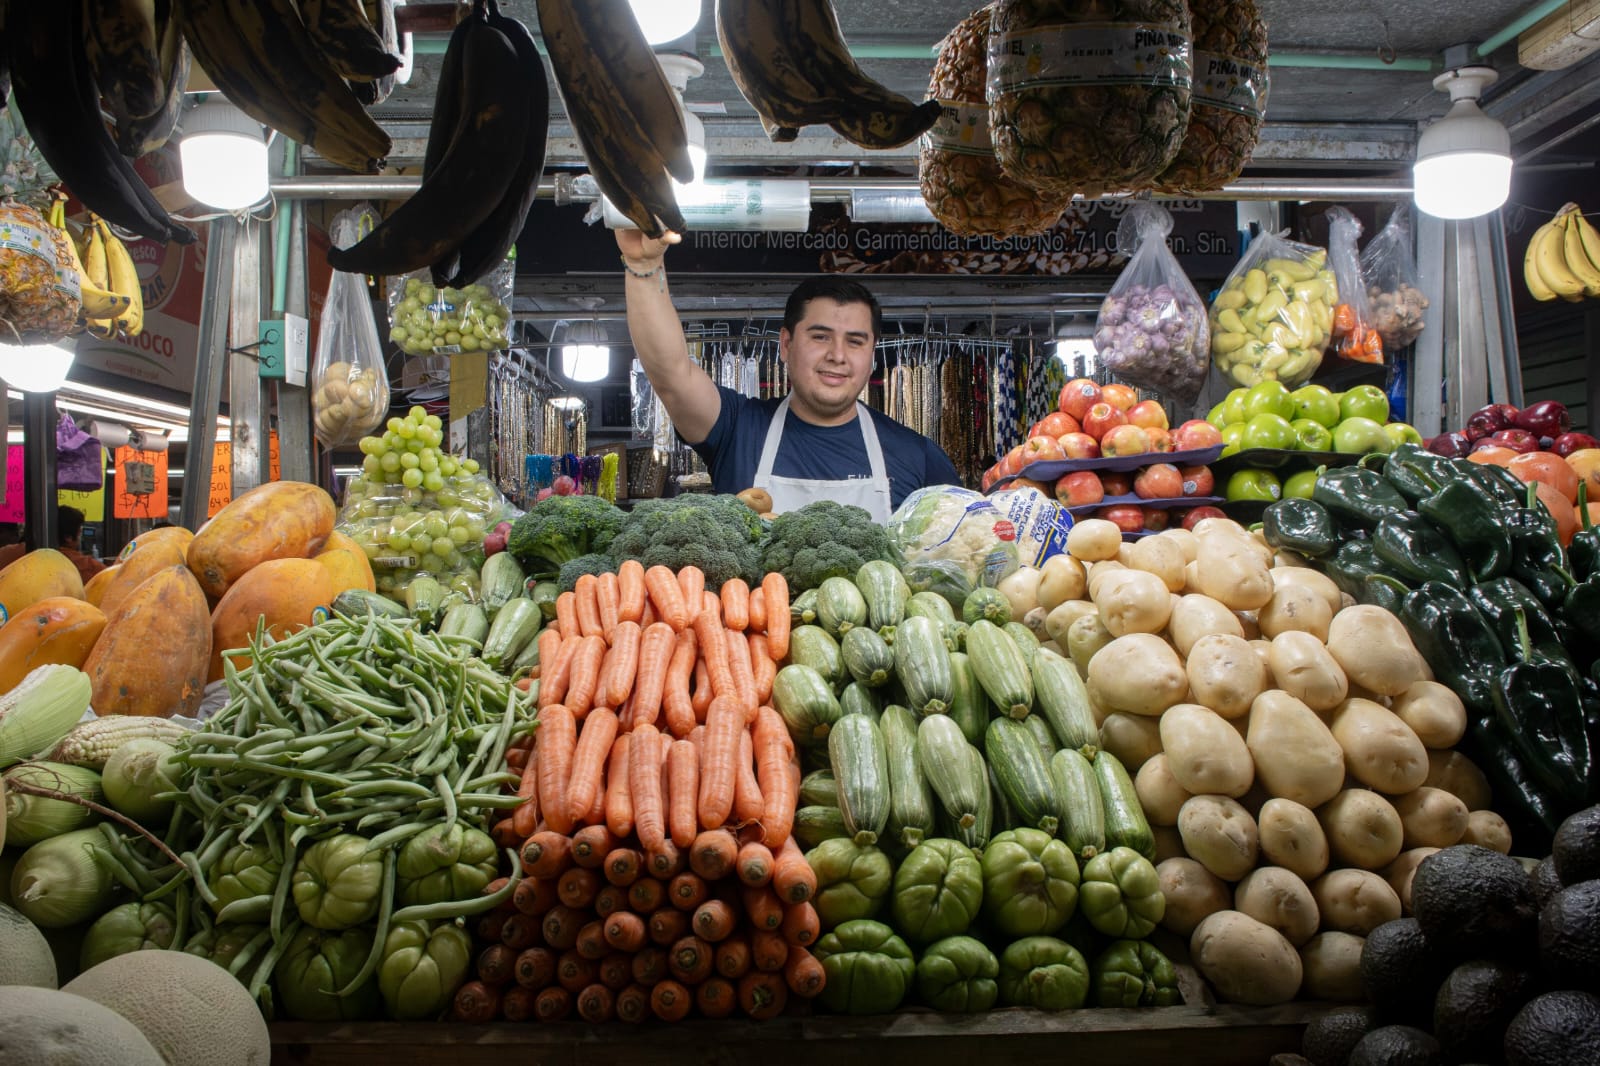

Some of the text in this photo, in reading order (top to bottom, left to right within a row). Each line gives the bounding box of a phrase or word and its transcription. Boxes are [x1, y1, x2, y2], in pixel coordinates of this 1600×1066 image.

[1207, 59, 1238, 76] PIÑA
[694, 230, 759, 250] Interior
[767, 230, 849, 250] Mercado
[856, 229, 959, 251] Garmendia
[966, 232, 1030, 252] Puesto
[1037, 231, 1070, 252] No.
[1076, 231, 1098, 252] 71
[1197, 232, 1232, 253] Sin.
[132, 245, 157, 259] resco
